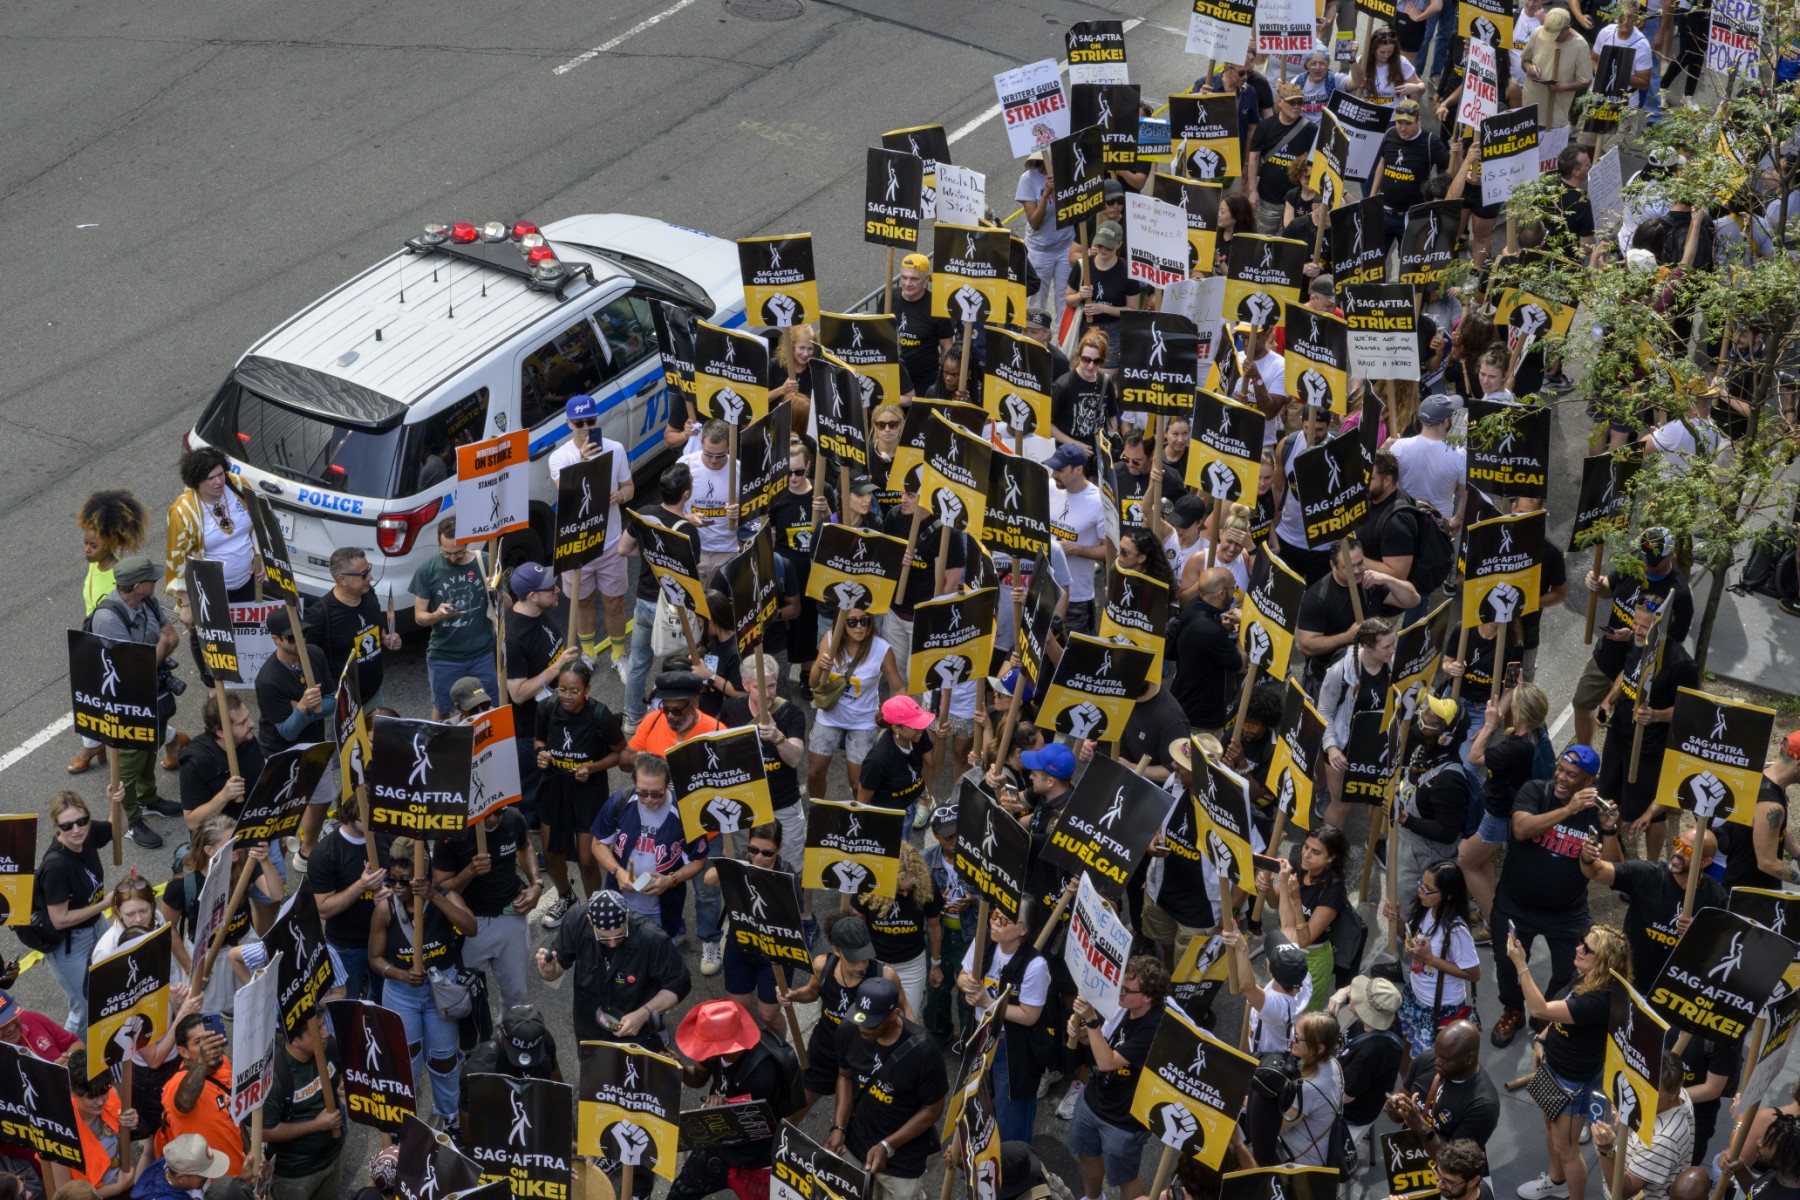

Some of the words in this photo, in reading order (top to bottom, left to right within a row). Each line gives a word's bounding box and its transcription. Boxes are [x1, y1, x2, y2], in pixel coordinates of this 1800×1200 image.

[1196, 1, 1252, 24] STRIKE!
[1260, 37, 1313, 50] STRIKE!
[1070, 49, 1124, 62] STRIKE!
[1002, 88, 1035, 103] WRITERS
[1037, 81, 1059, 92] GUILD
[1006, 92, 1065, 124] STRIKE!
[1483, 134, 1536, 157] HUELGA!
[1384, 169, 1415, 180] STRONG
[1057, 191, 1103, 222] STRIKE!
[1077, 193, 1088, 202] ON
[867, 221, 917, 242] STRIKE!
[1131, 248, 1160, 264] WRITERS
[1162, 258, 1184, 270] GUILD
[768, 274, 804, 283] STRIKE!
[944, 265, 961, 273] ON
[964, 267, 996, 277] STRIKE!
[1238, 272, 1253, 280] ON
[1254, 274, 1290, 286] STRIKE!
[1348, 316, 1412, 329] STRIKE!
[849, 354, 886, 362] STRIKE!
[1294, 344, 1306, 353] ON
[1307, 348, 1337, 366] STRIKE!
[721, 369, 757, 384] STRIKE!
[996, 368, 1008, 377] ON
[1009, 372, 1041, 391] STRIKE!
[1150, 383, 1164, 392] ON
[1123, 387, 1193, 408] STRIKE!
[836, 434, 847, 442] ON
[1201, 434, 1214, 443] ON
[1215, 438, 1250, 457] STRIKE!
[474, 458, 487, 470] ON
[488, 447, 512, 466] STRIKE
[476, 449, 499, 458] WRITERS
[820, 435, 866, 464] STRIKE!
[931, 458, 945, 468] ON
[944, 464, 977, 489] STRIKE!
[1469, 468, 1544, 486] HUELGA!
[1501, 465, 1513, 473] EN
[478, 477, 498, 489] STANDS
[298, 488, 363, 514] POLICE
[741, 476, 788, 517] STRIKE!
[1308, 500, 1367, 539] STRIKE!
[1333, 505, 1345, 516] ON
[1006, 525, 1020, 535] ON
[556, 530, 605, 560] HUELGA!
[657, 558, 690, 576] STRIKE!
[827, 559, 843, 569] ON
[845, 564, 886, 576] STRIKE!
[1476, 566, 1492, 576] ON
[1493, 558, 1532, 573] STRIKE!
[1118, 613, 1153, 632] STRIKE!
[207, 643, 218, 652] ON
[923, 640, 940, 648] ON
[942, 629, 980, 646] STRIKE!
[1066, 679, 1082, 688] ON
[1084, 683, 1126, 695] STRIKE!
[77, 711, 155, 742] STRIKE!
[104, 713, 120, 724] ON
[1681, 743, 1699, 756] ON
[1702, 748, 1749, 767] STRIKE!
[687, 781, 704, 791] ON
[706, 773, 751, 788] STRIKE!
[373, 807, 463, 830] STRIKE!
[409, 805, 427, 814] ON
[235, 814, 300, 842] STRIKE!
[820, 838, 836, 848] ON
[838, 842, 886, 855] STRIKE!
[1089, 841, 1101, 852] EN
[1052, 831, 1128, 885] HUELGA!
[980, 866, 992, 879] ON
[956, 853, 1017, 914] STRIKE!
[761, 934, 775, 944] ON
[872, 924, 918, 935] STRONG
[1078, 898, 1098, 940] WRITERS
[1100, 937, 1123, 963] GUILD
[1110, 923, 1130, 950] LOST
[736, 930, 809, 964] STRIKE!
[1072, 914, 1120, 987] STRIKE!
[100, 1003, 118, 1016] ON
[121, 979, 160, 1010] STRIKE!
[285, 960, 331, 1031] STRIKE!
[1695, 996, 1714, 1010] ON
[1651, 987, 1745, 1039] STRIKE!
[371, 1092, 385, 1103] ON
[1159, 1066, 1176, 1082] ON
[1174, 1076, 1226, 1111] STRIKE!
[596, 1092, 616, 1104] ON
[618, 1097, 666, 1118] STRIKE!
[2, 1120, 82, 1164] STRIKE!
[510, 1168, 528, 1178] ON
